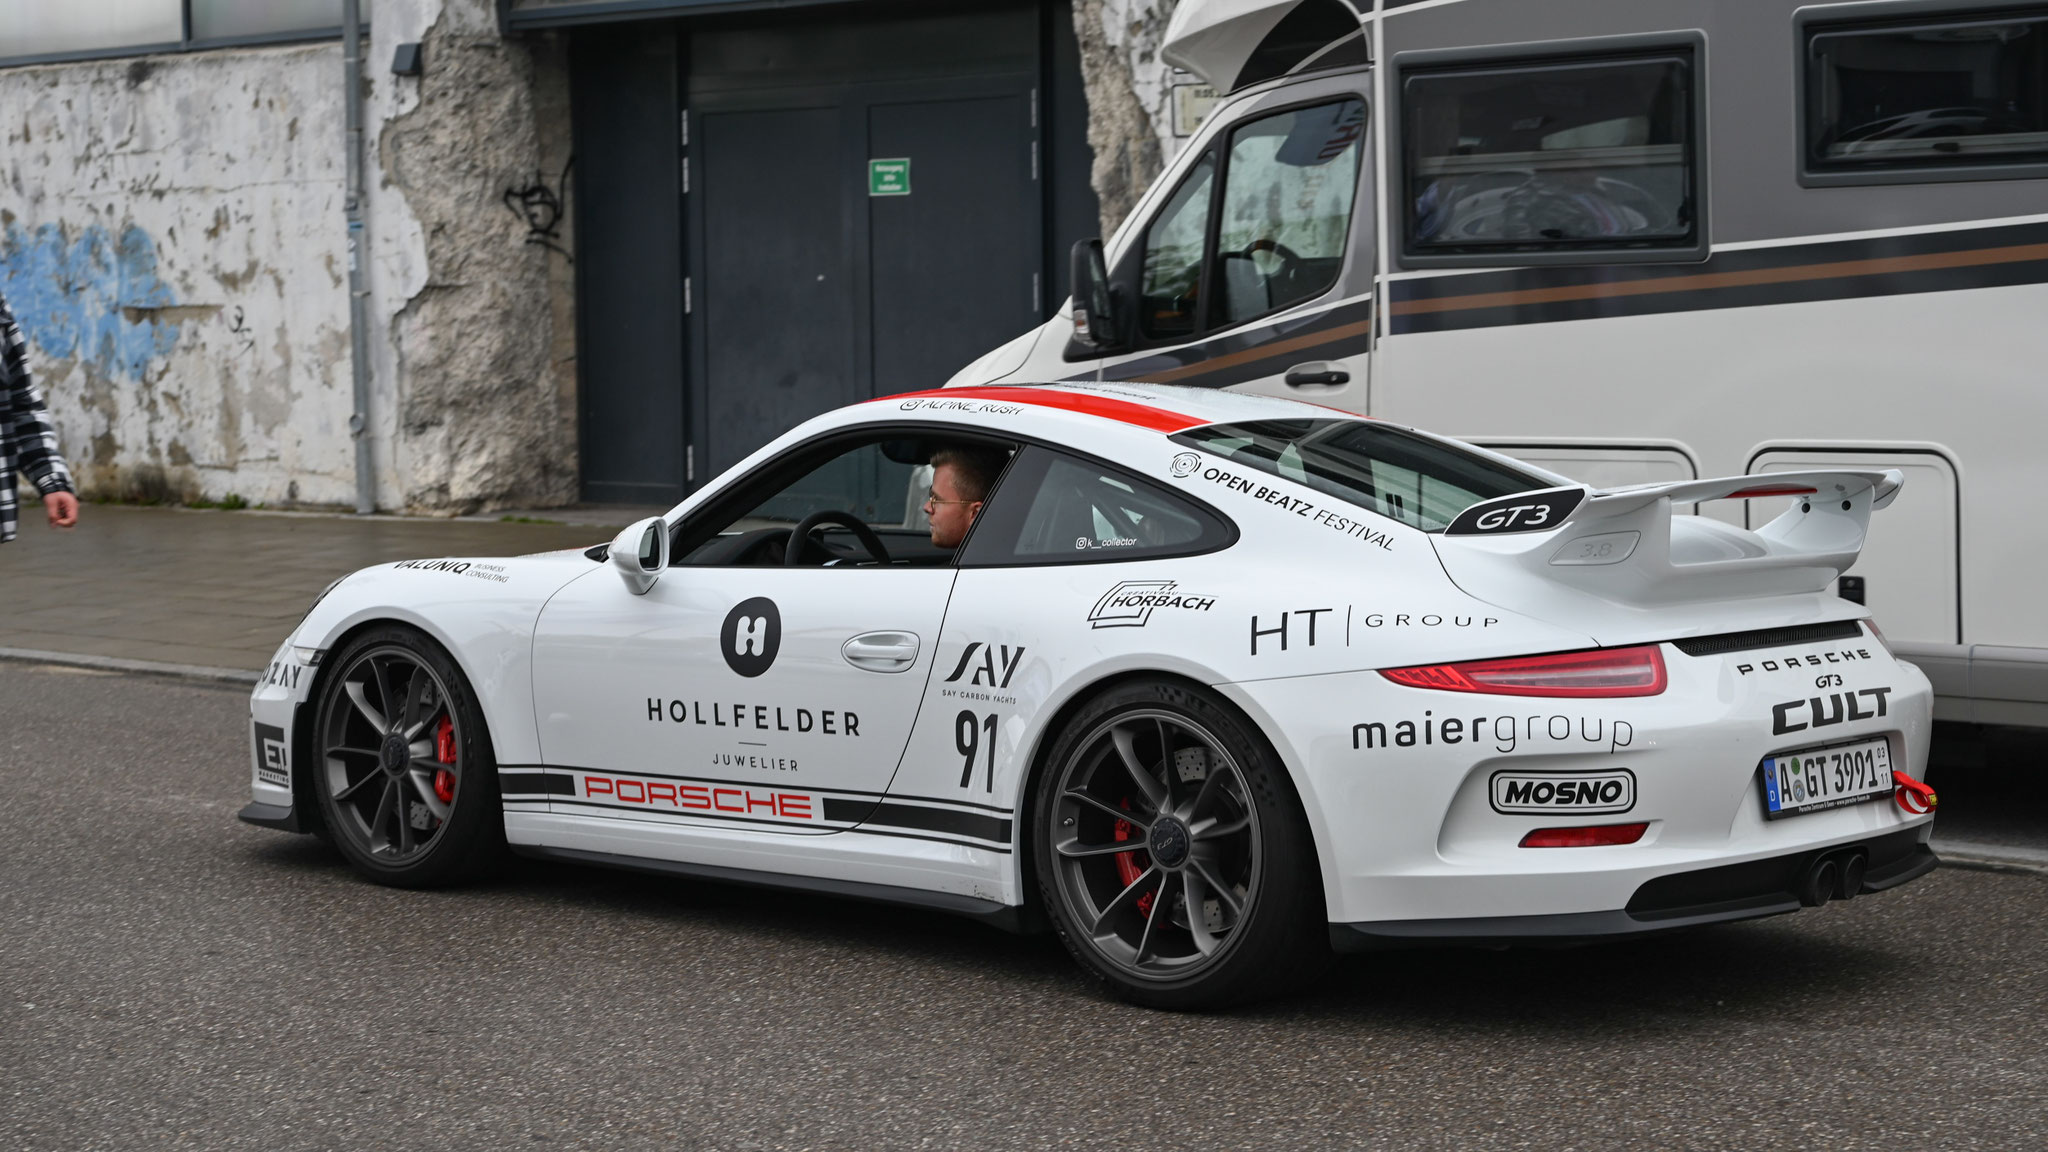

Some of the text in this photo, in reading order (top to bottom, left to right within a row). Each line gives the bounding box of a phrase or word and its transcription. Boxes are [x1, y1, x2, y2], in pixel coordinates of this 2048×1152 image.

[1203, 467, 1255, 494] OPEN
[1254, 486, 1314, 517] BEATZ
[1313, 508, 1395, 552] FESTIVAL
[1476, 504, 1551, 530] GT3
[1580, 543, 1613, 558] 3.8
[465, 570, 510, 583] CONSULTING
[1110, 595, 1216, 611] HORBACH
[1250, 608, 1499, 656] HT GROUP
[944, 642, 1026, 689] SAY
[1736, 649, 1871, 676] PORSCHE
[1815, 674, 1843, 689] GT3
[942, 689, 1017, 705] SAY CARBON YACHTS
[647, 698, 860, 737] HOLLFELDER
[1772, 686, 1892, 736] CULT
[1352, 710, 1633, 754] maiergroup
[713, 753, 798, 772] JUWELIER
[955, 709, 999, 794] 91
[1876, 746, 1886, 759] 03
[1780, 749, 1878, 803] A GT 3991
[1880, 772, 1889, 784] 11
[584, 776, 812, 819] PORSCHE
[1504, 780, 1623, 805] MOSNO
[1769, 790, 1776, 802] D
